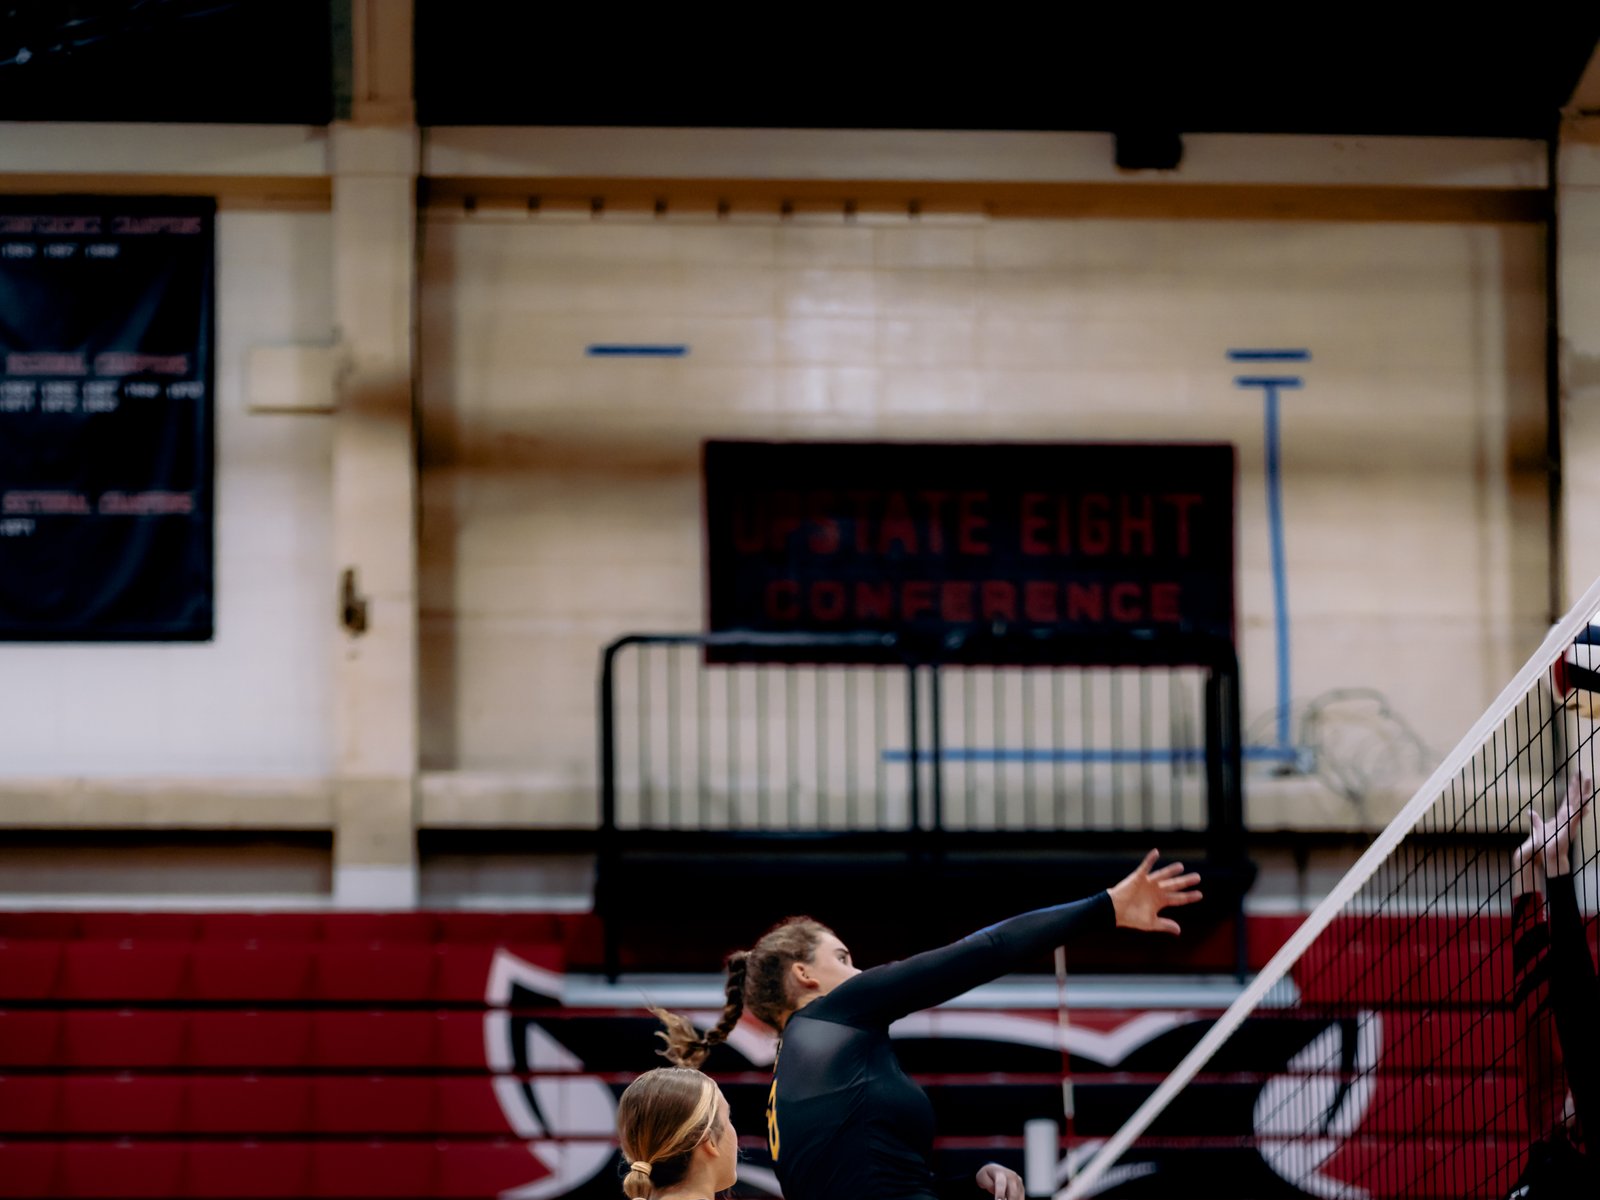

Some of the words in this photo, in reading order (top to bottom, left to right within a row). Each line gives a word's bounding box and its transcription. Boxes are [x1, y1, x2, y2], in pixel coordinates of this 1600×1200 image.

[732, 491, 992, 555] UPSTATE
[1019, 492, 1204, 557] EIGHT
[764, 580, 1183, 622] CONFERENCE
